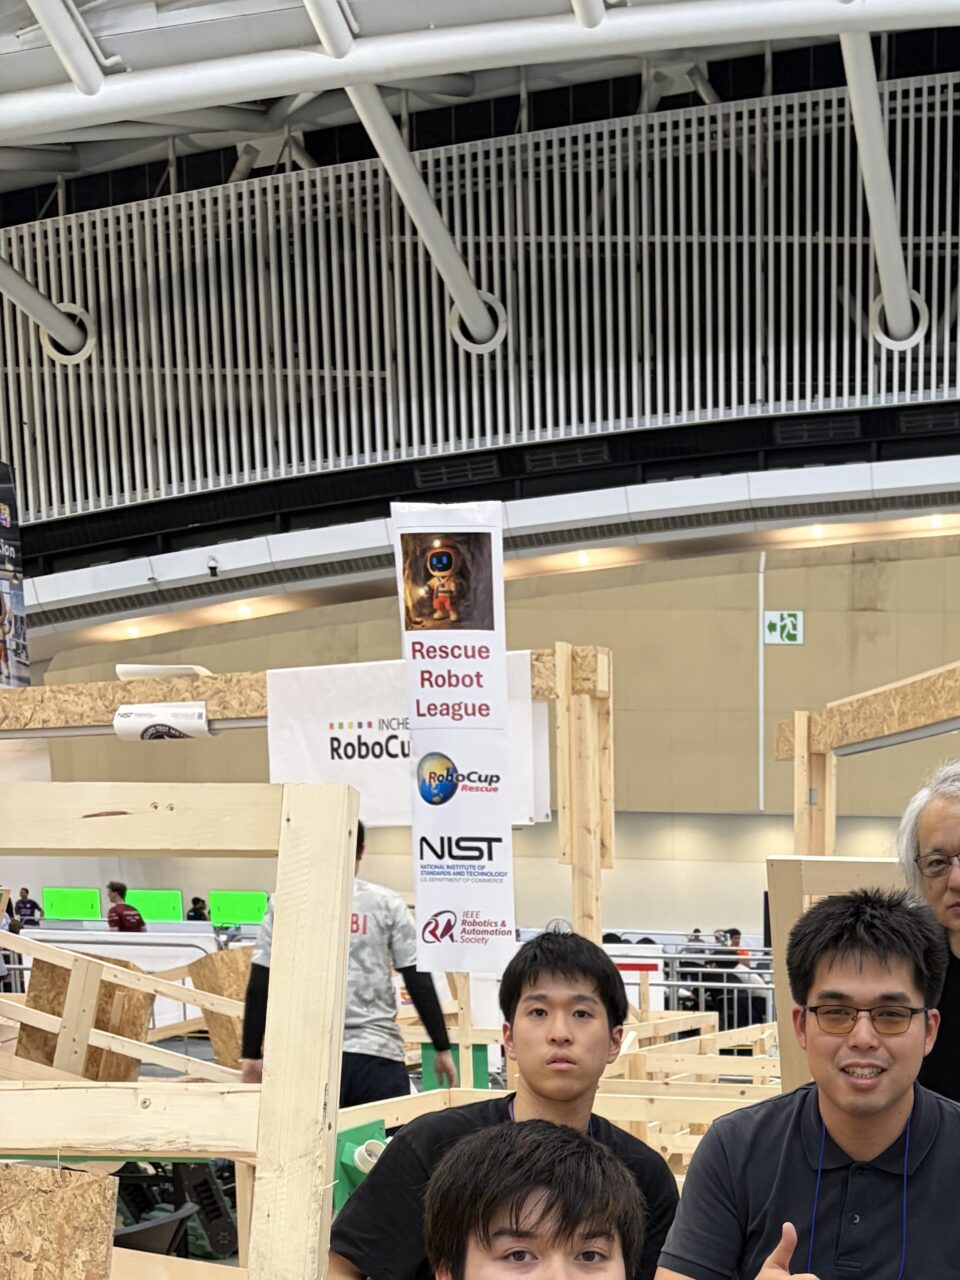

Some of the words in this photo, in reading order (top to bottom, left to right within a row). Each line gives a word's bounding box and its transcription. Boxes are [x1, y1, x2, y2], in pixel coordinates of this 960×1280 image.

[411, 641, 490, 660] Rescue
[420, 669, 484, 689] Robot
[416, 699, 491, 722] League
[378, 718, 410, 731] INCHE
[330, 735, 410, 760] RoboCu
[428, 771, 501, 786] RoboCup
[460, 784, 499, 793] Rescue
[420, 836, 503, 861] NIST
[462, 910, 481, 918] IEEE
[461, 919, 498, 927] Robotics
[460, 928, 512, 936] Automation
[460, 936, 490, 945] Society
